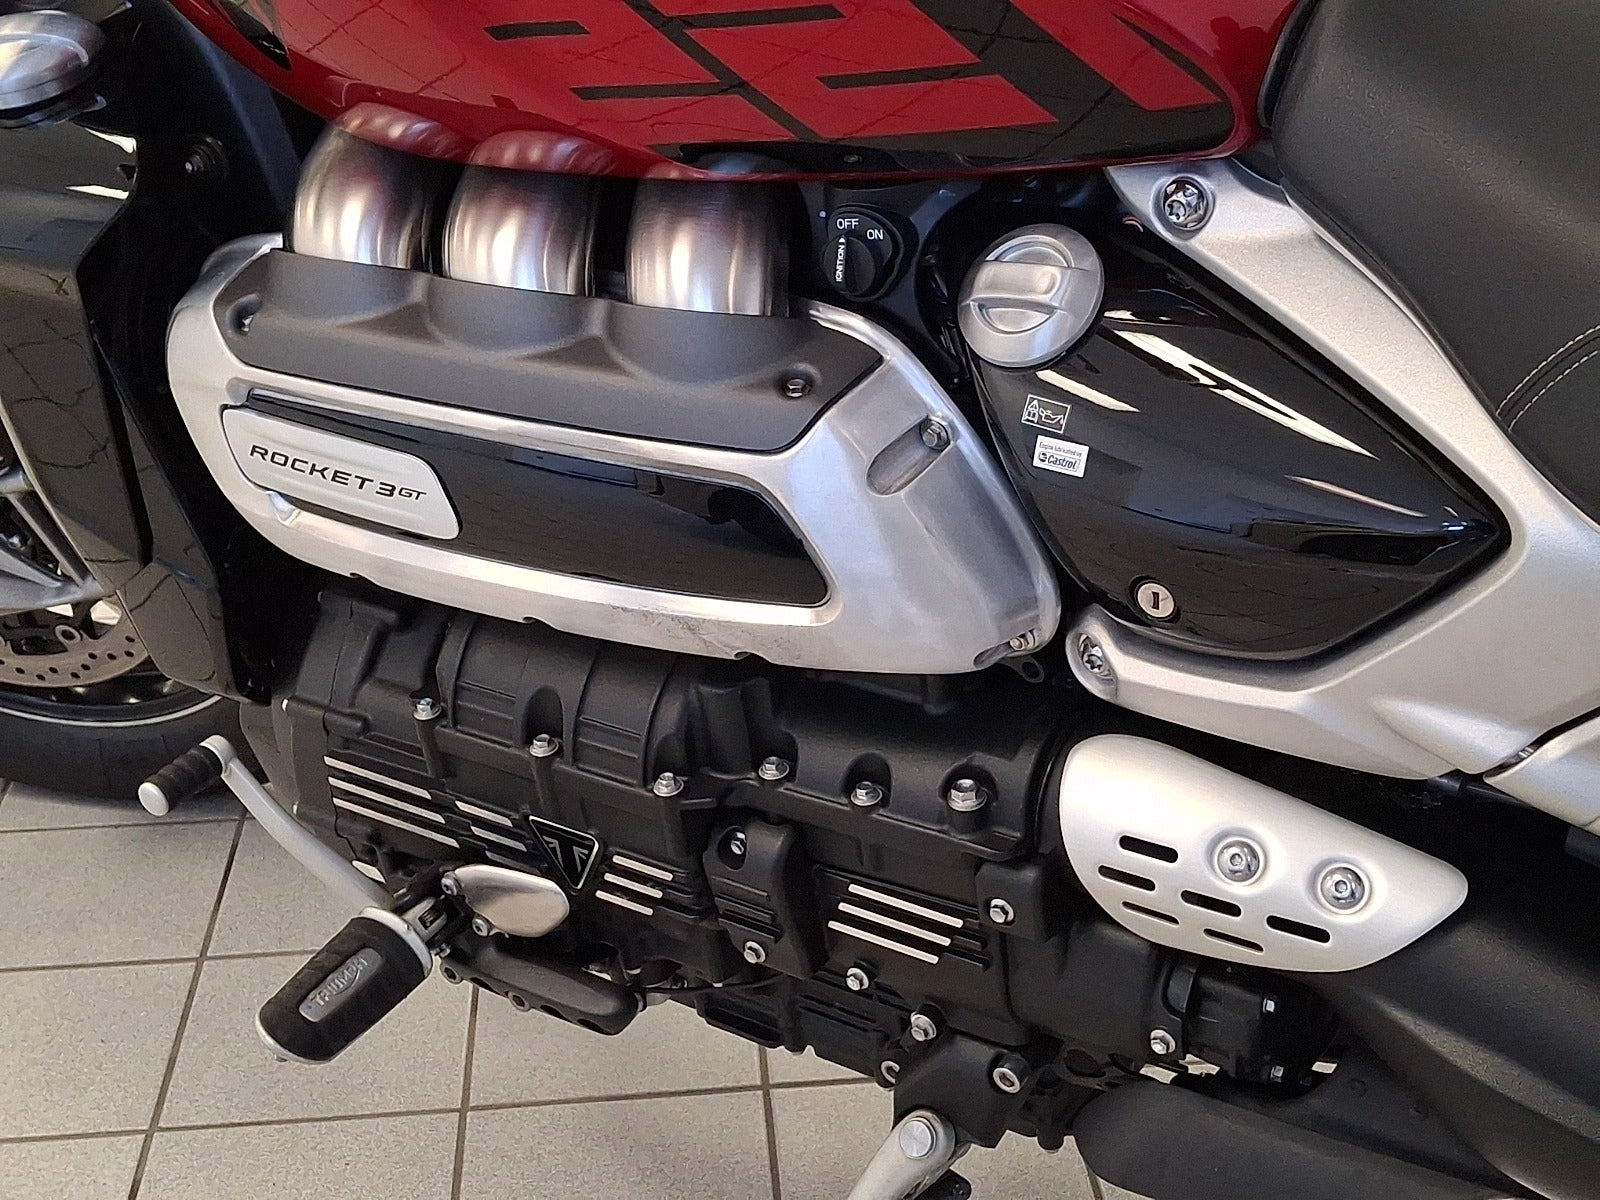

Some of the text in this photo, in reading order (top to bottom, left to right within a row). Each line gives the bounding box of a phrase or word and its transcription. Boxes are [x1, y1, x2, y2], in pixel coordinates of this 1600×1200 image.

[836, 218, 859, 230] OFF
[866, 229, 884, 240] ON
[835, 244, 846, 282] IGNITION
[1047, 454, 1078, 470] Castrol
